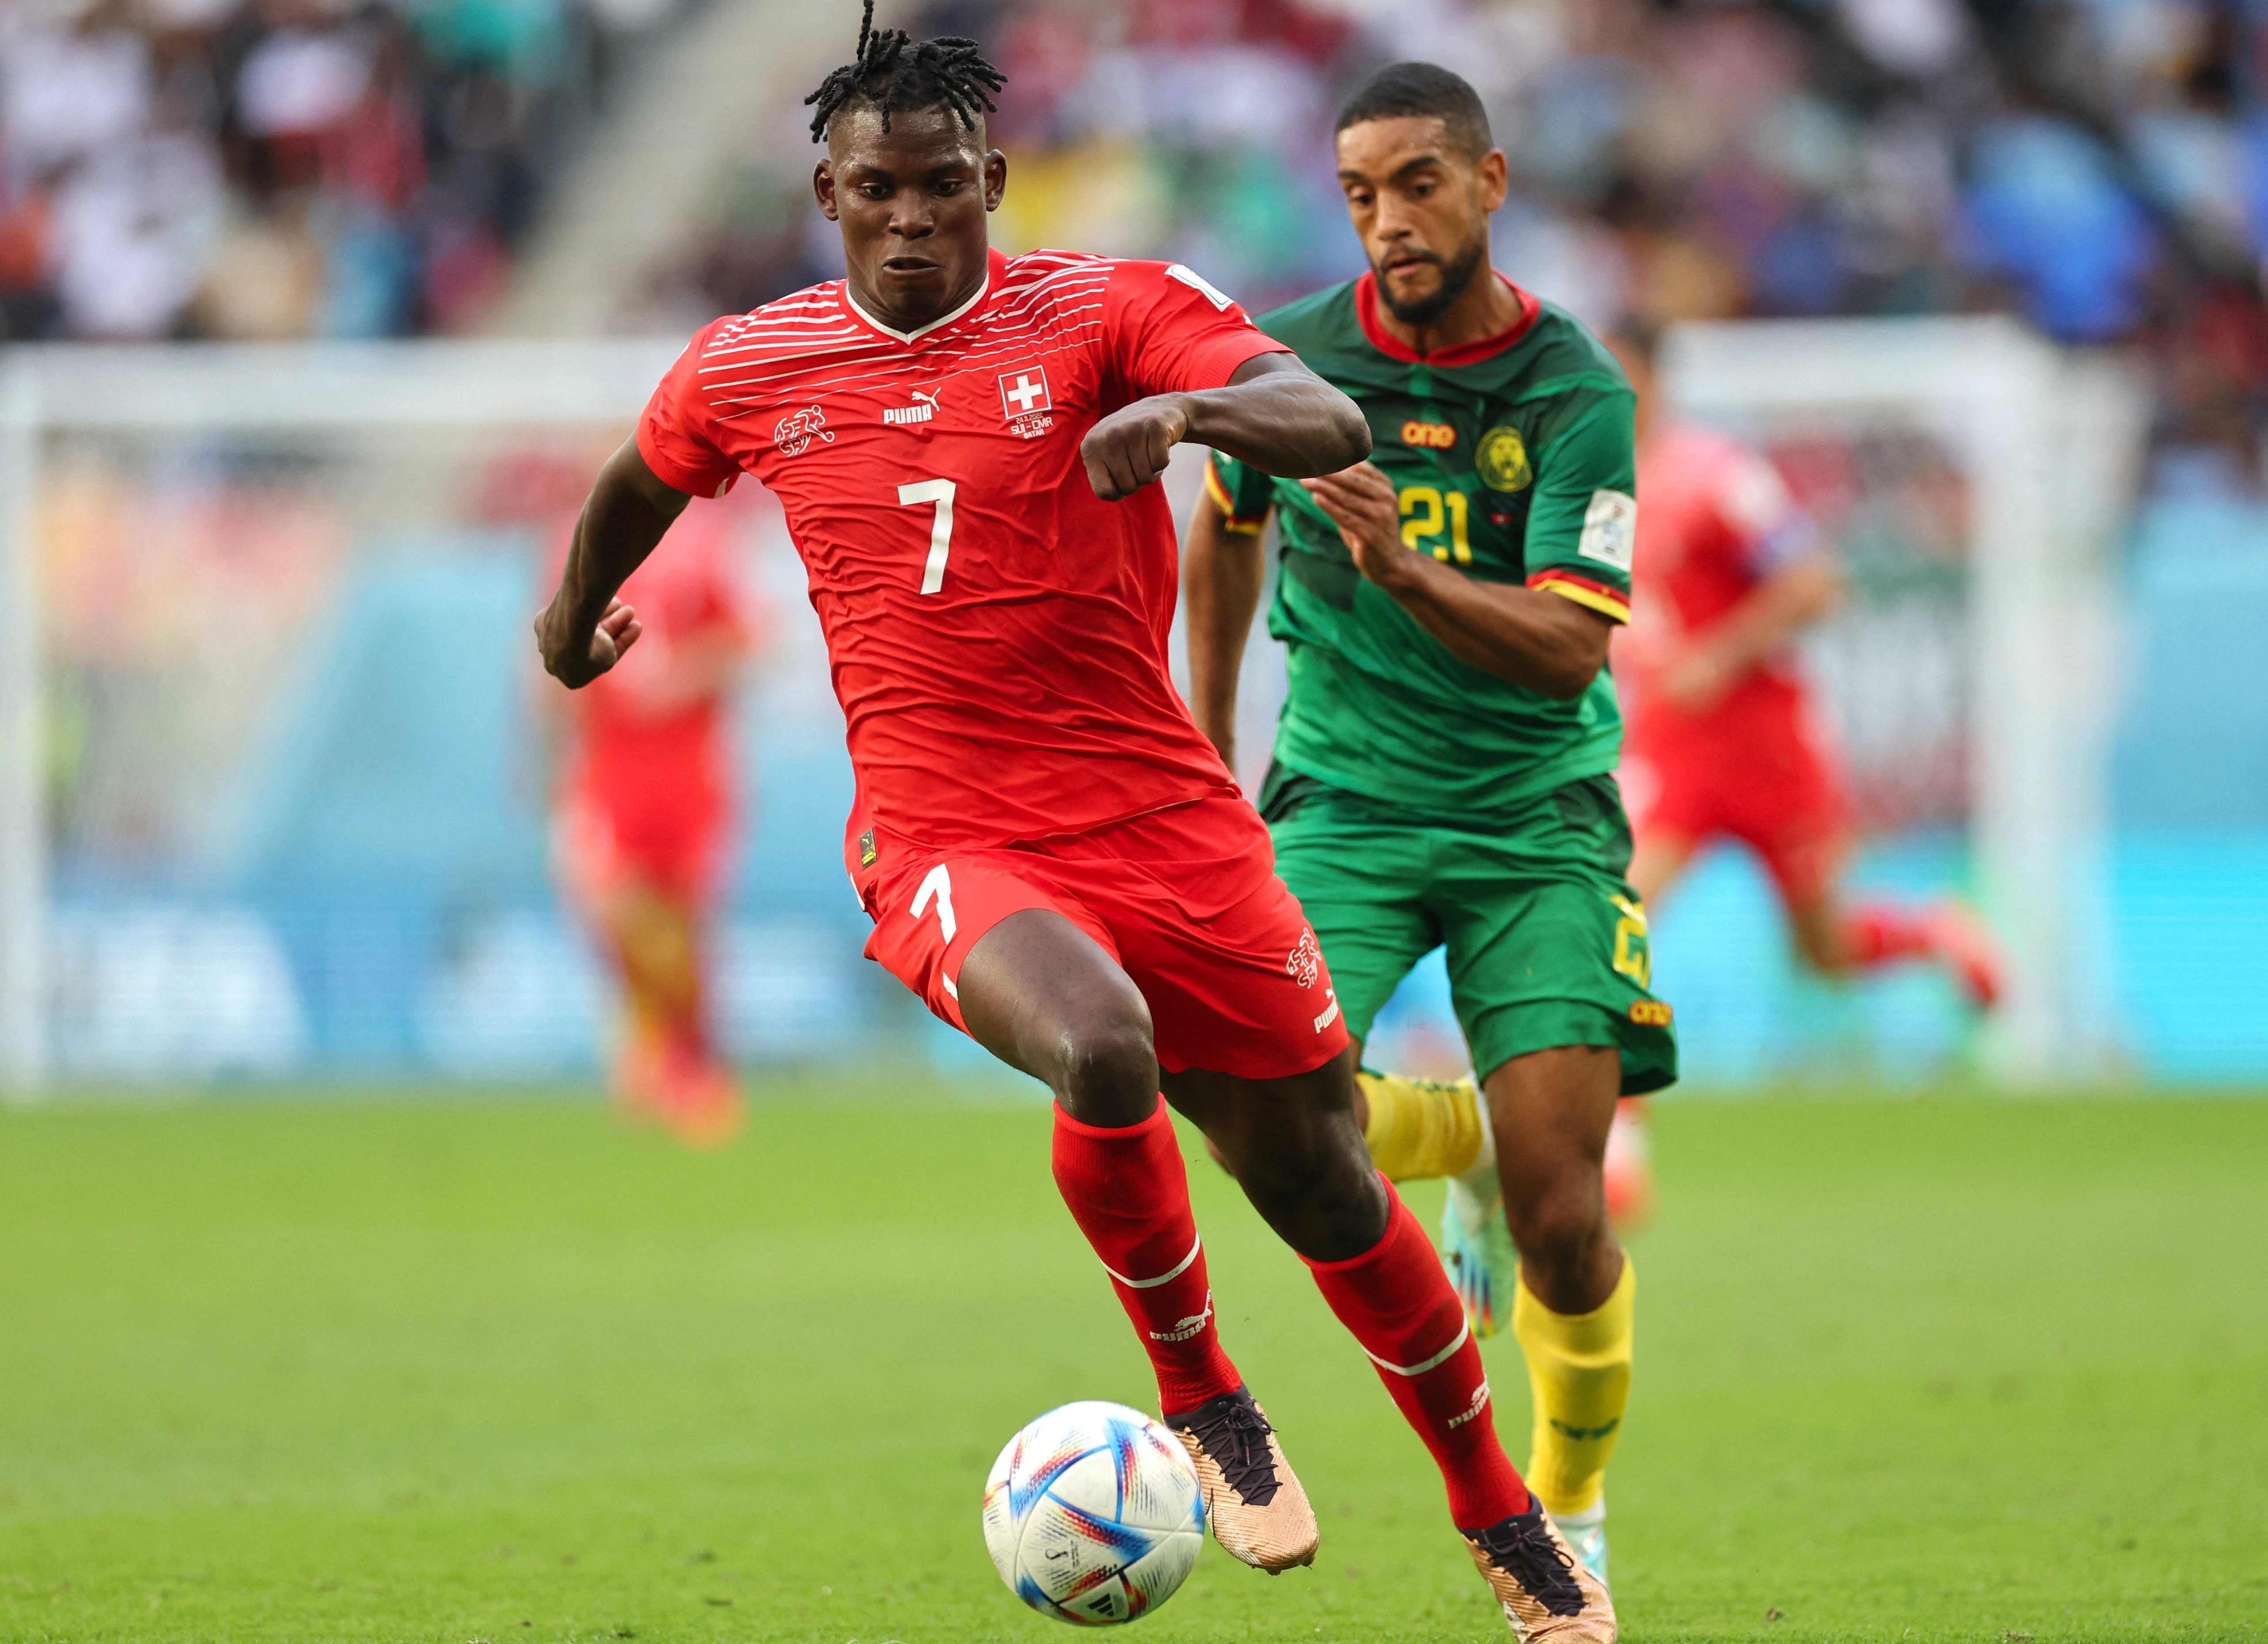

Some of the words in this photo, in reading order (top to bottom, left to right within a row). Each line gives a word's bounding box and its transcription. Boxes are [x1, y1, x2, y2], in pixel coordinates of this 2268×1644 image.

[883, 403, 932, 424] PUMA
[1023, 428, 1045, 439] QATAR
[897, 479, 956, 595] 7
[1398, 486, 1473, 565] 21
[909, 863, 957, 945] 7
[1150, 1319, 1206, 1341] PUMA
